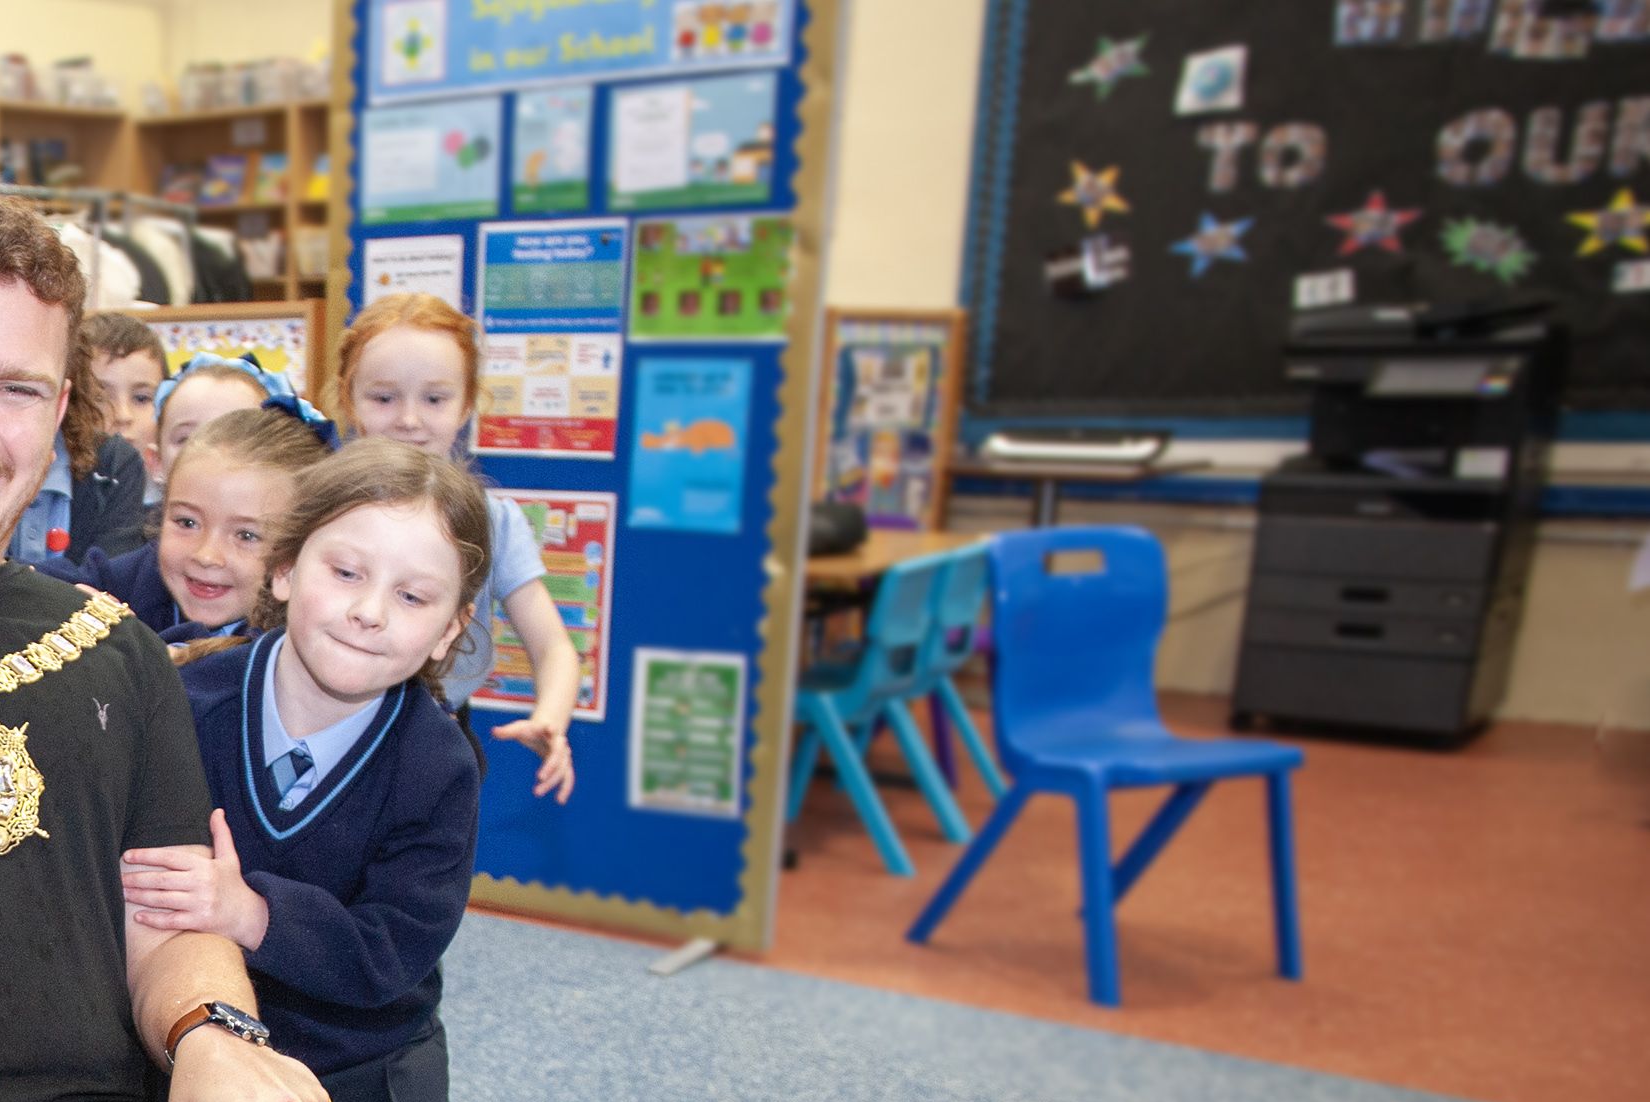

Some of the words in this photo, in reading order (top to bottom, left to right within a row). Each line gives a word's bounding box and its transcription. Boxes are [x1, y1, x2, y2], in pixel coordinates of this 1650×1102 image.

[503, 46, 549, 71] our
[558, 25, 655, 64] School
[1197, 121, 1327, 191] TO
